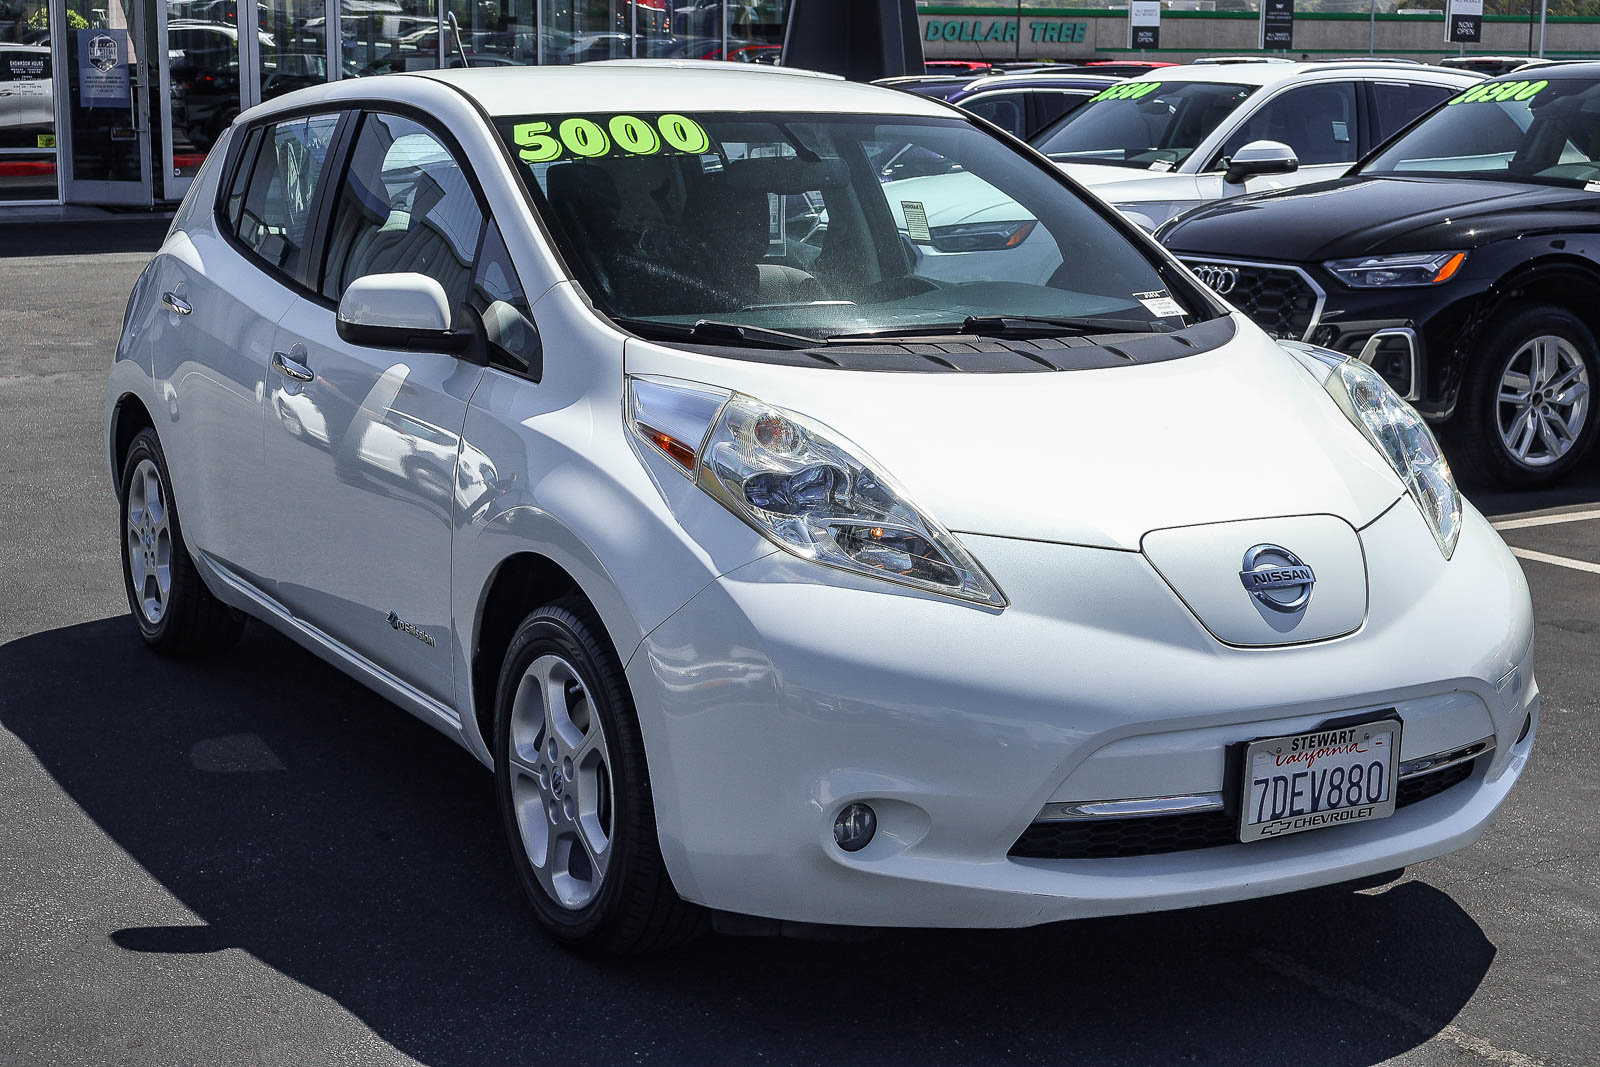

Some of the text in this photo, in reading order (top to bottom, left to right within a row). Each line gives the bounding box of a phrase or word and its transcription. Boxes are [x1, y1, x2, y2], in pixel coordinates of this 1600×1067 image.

[925, 20, 1088, 43] DOLLAR TREE
[513, 114, 710, 164] 5000
[1252, 569, 1311, 584] NISSAN
[1291, 729, 1356, 752] STEWART
[1275, 742, 1368, 768] California
[1253, 760, 1384, 823] 7DEV880
[1293, 806, 1376, 829] CHEVROLET
